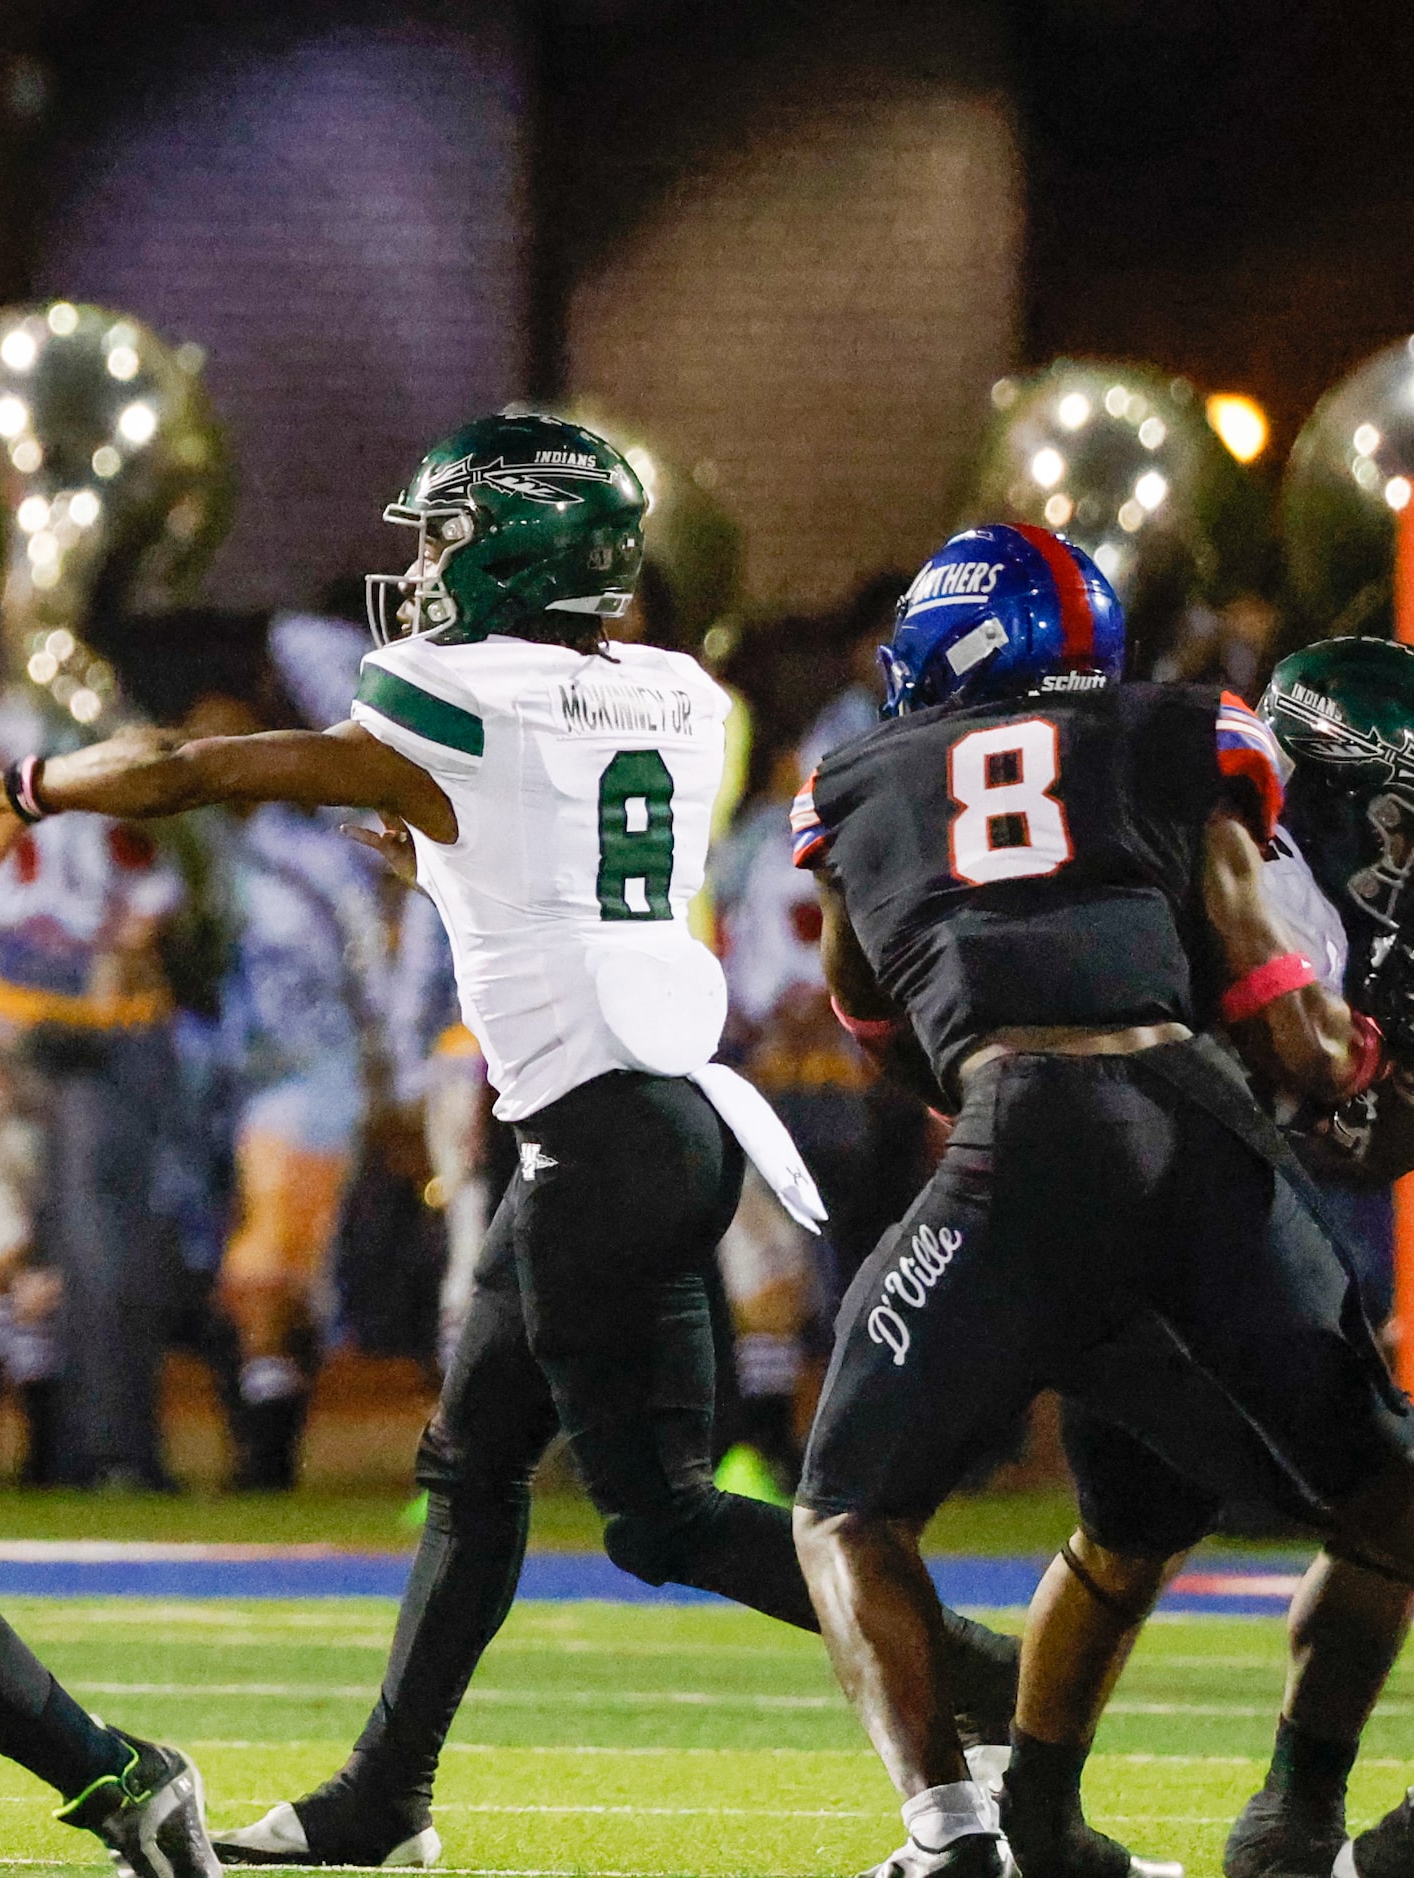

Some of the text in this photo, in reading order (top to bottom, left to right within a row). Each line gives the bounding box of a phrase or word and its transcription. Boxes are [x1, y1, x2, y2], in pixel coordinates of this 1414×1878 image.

[534, 450, 597, 468] INDIANS
[671, 690, 693, 736] JR
[1290, 682, 1343, 721] INDIANS
[596, 749, 675, 922] 8
[947, 715, 1075, 887] 8
[867, 1223, 963, 1366] D'Ville
